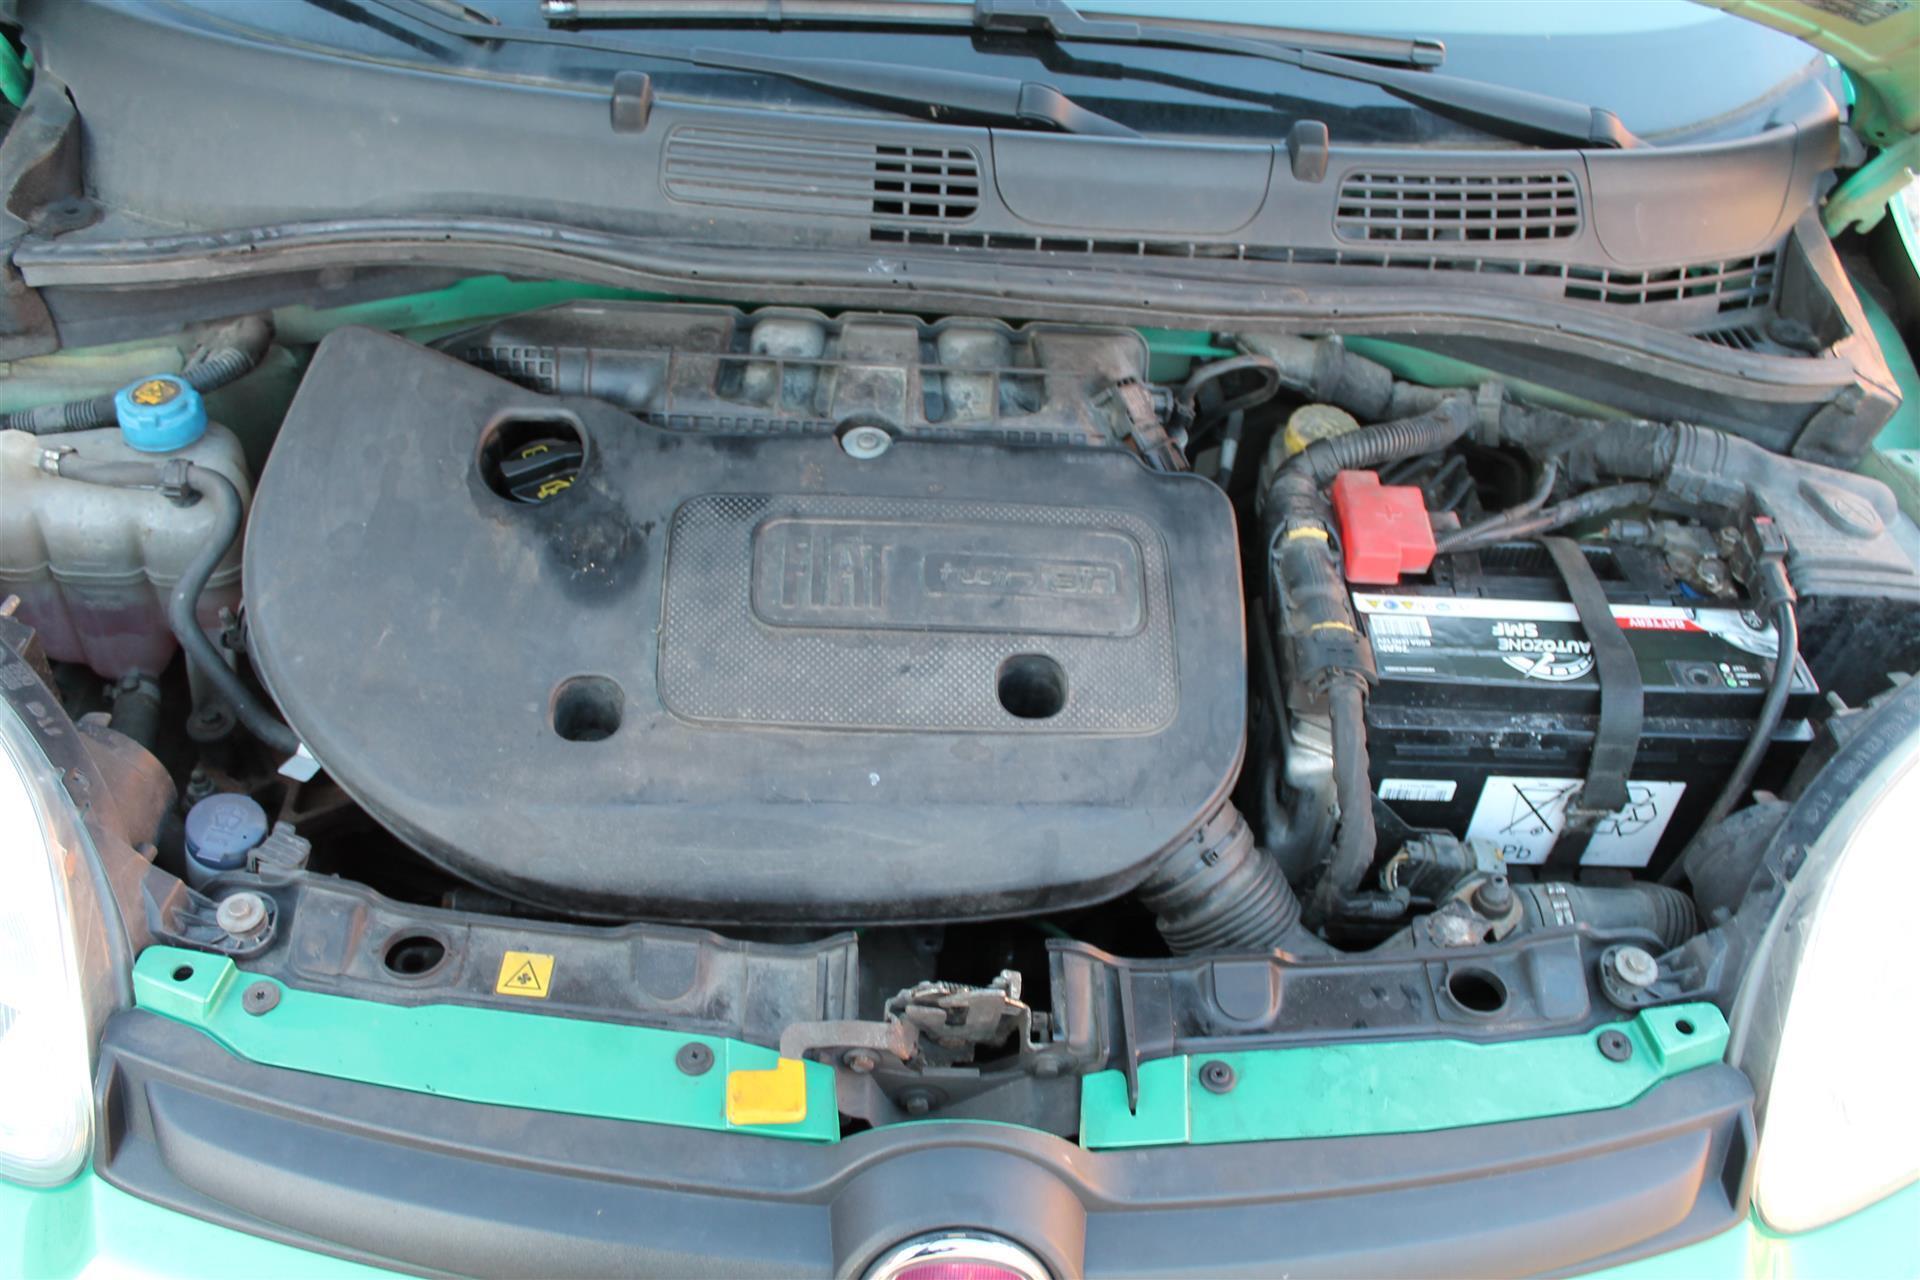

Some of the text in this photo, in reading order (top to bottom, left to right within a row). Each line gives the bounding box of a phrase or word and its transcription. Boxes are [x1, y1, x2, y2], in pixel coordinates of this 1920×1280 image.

[1491, 622, 1539, 638] SMF
[1629, 617, 1686, 631] BATTERY
[1497, 638, 1592, 654] AUTOZONE
[1502, 844, 1532, 860] Pb
